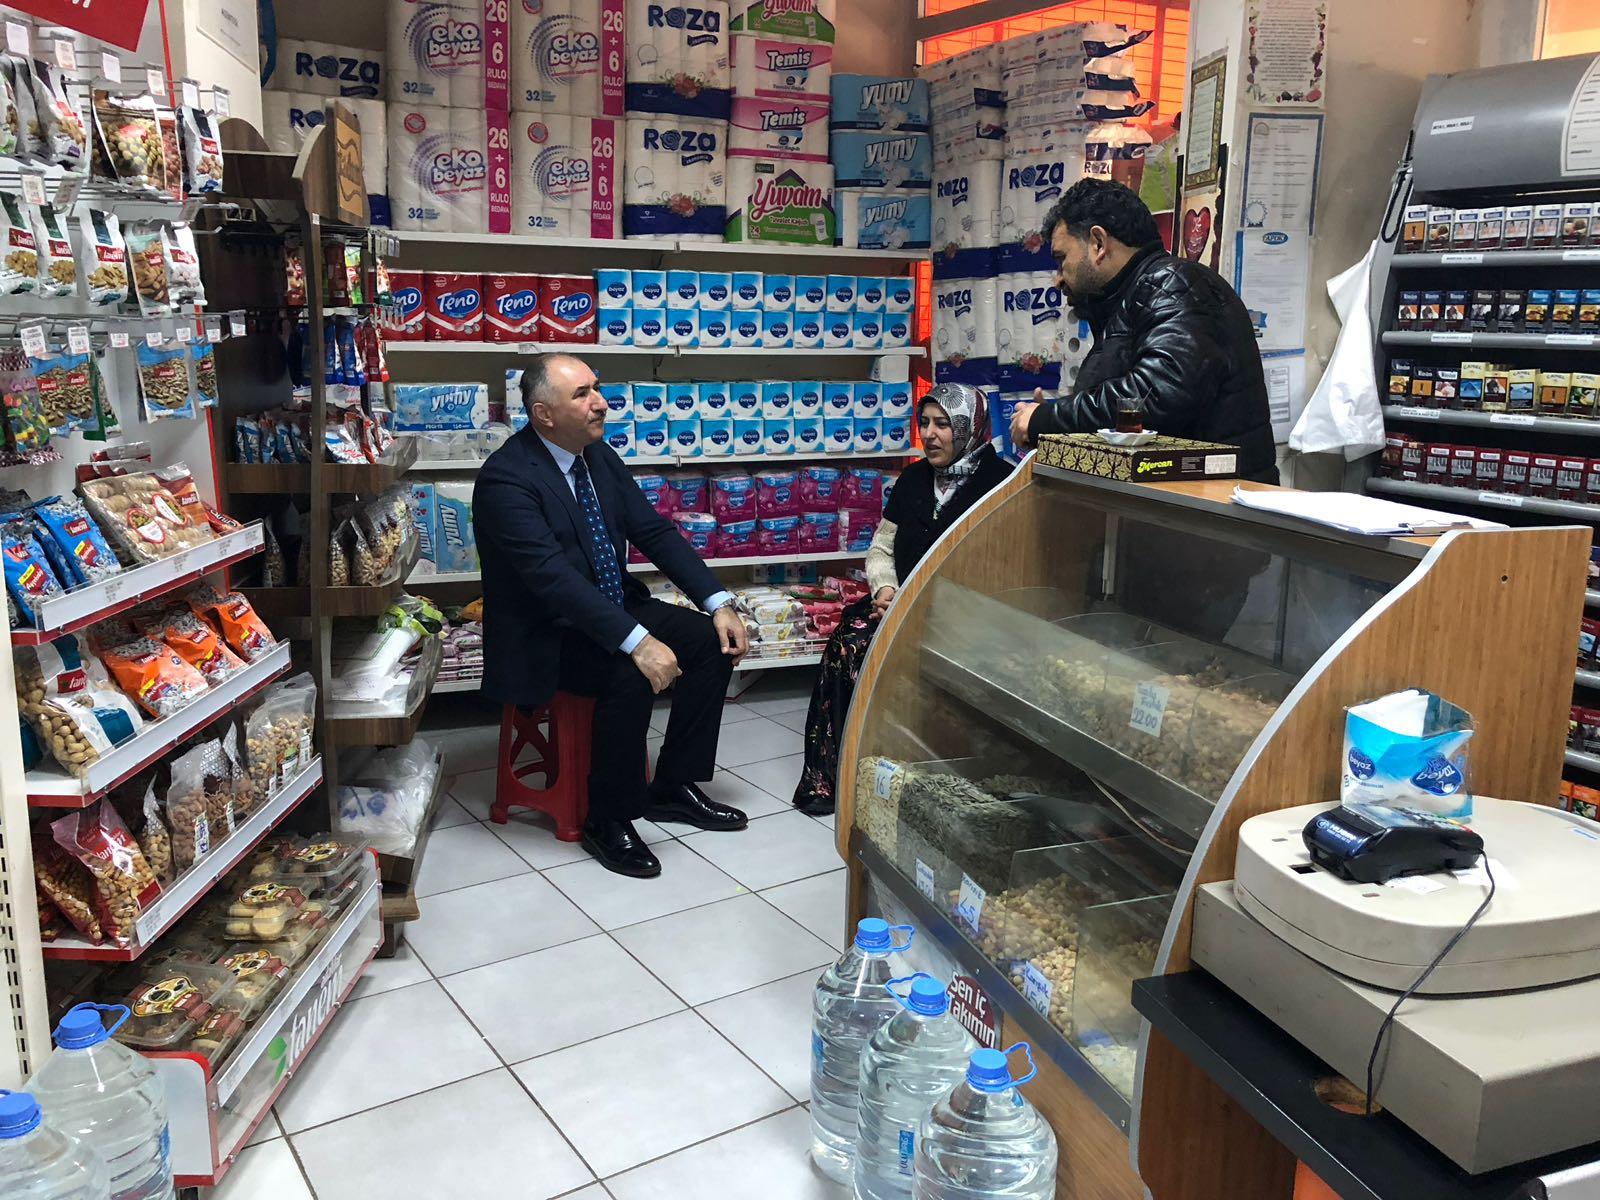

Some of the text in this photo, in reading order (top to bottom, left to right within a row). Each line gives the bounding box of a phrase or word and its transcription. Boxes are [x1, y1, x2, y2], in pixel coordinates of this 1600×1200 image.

[486, 0, 507, 22] 26
[603, 10, 623, 32] 26
[432, 20, 479, 41] eko
[430, 40, 481, 58] beyaz
[553, 31, 597, 52] eko
[492, 42, 503, 64] 6
[550, 49, 598, 68] beyaz
[609, 51, 619, 72] 6
[767, 48, 811, 71] Temis
[487, 68, 507, 79] RULO
[604, 76, 623, 87] RULO
[403, 81, 418, 93] 32
[525, 90, 541, 101] 32
[861, 79, 914, 110] yumy
[761, 108, 806, 131] Temis
[488, 127, 508, 149] 26
[593, 136, 612, 159] 26
[435, 149, 482, 170] eko
[865, 137, 917, 168] yumy
[551, 157, 588, 174] eko
[433, 166, 485, 186] beyaz
[495, 168, 506, 188] 6
[549, 172, 589, 188] beyaz
[599, 176, 608, 196] 6
[491, 193, 509, 203] RULO
[593, 201, 612, 210] RULO
[751, 178, 821, 221] Yuvam
[408, 207, 424, 219] 32
[528, 216, 542, 227] 32
[866, 200, 907, 227] yumy
[438, 293, 475, 312] Teno
[497, 293, 533, 313] Teno
[552, 296, 588, 316] Teno
[440, 504, 464, 546] yumy
[1350, 756, 1371, 770] beyaz
[1417, 765, 1456, 780] beyaz
[950, 971, 987, 1018] Sen iç
[948, 991, 995, 1048] Takımın
